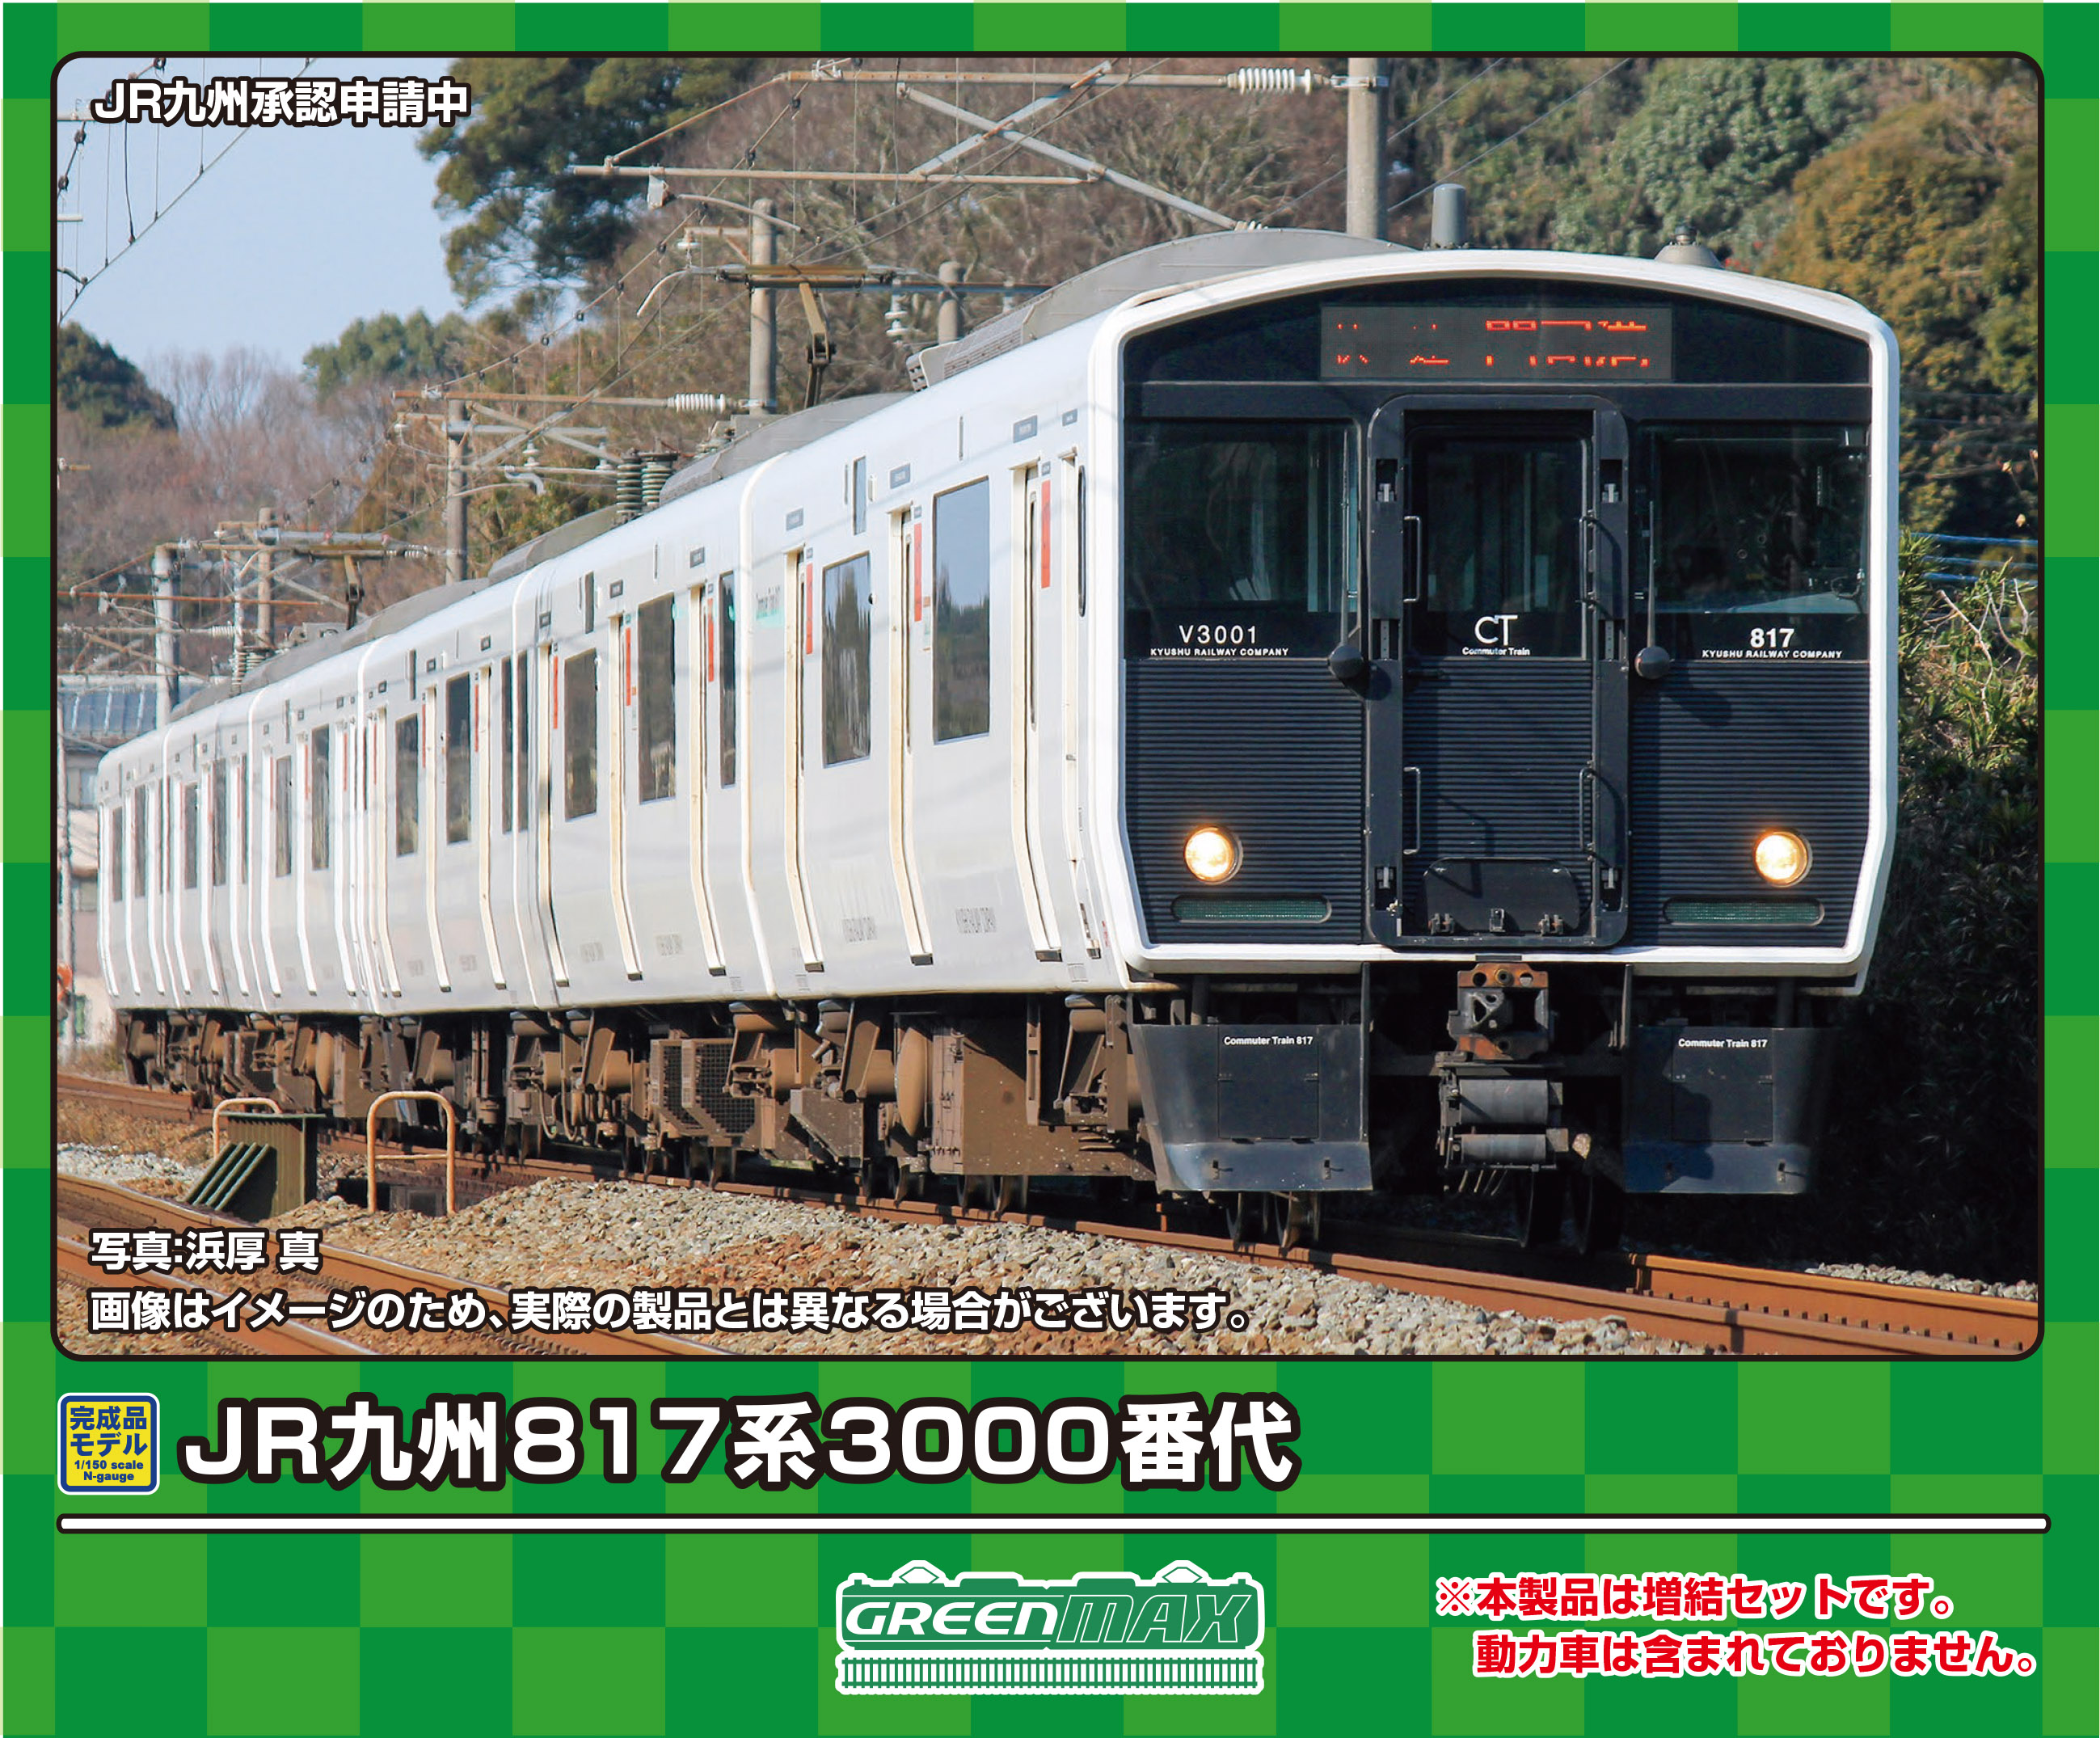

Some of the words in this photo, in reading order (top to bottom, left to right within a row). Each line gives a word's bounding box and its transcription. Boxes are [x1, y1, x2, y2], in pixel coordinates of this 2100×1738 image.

[1179, 624, 1256, 644] V3001
[1474, 614, 1518, 646] CT
[1750, 627, 1794, 648] 817
[1150, 648, 1191, 656] KYUSHU
[1194, 648, 1237, 656] RAILWAY
[1239, 648, 1288, 656] COMPANY
[1461, 647, 1508, 656] Commuter
[1508, 648, 1530, 656] Train
[1702, 649, 1744, 658] KYUSHU
[1745, 650, 1790, 659] RAILWAY
[1792, 650, 1842, 659] COMPANY
[1224, 1036, 1271, 1045] Commuter
[1271, 1036, 1295, 1045] Train
[1296, 1036, 1314, 1045] 817
[1678, 1038, 1725, 1048] Commuter
[1726, 1039, 1749, 1048] Train
[1750, 1039, 1769, 1048] 817
[70, 1405, 147, 1431] 完成品
[70, 1432, 148, 1457] モデル
[185, 1401, 1292, 1483] JR九州817系3000番代
[74, 1460, 107, 1470] 1/150
[111, 1460, 144, 1470] scale
[83, 1471, 134, 1483] N-gauge
[845, 1594, 1251, 1643] GREENMAX
[1477, 1634, 2033, 1674] 動力車は含まれておりません。
